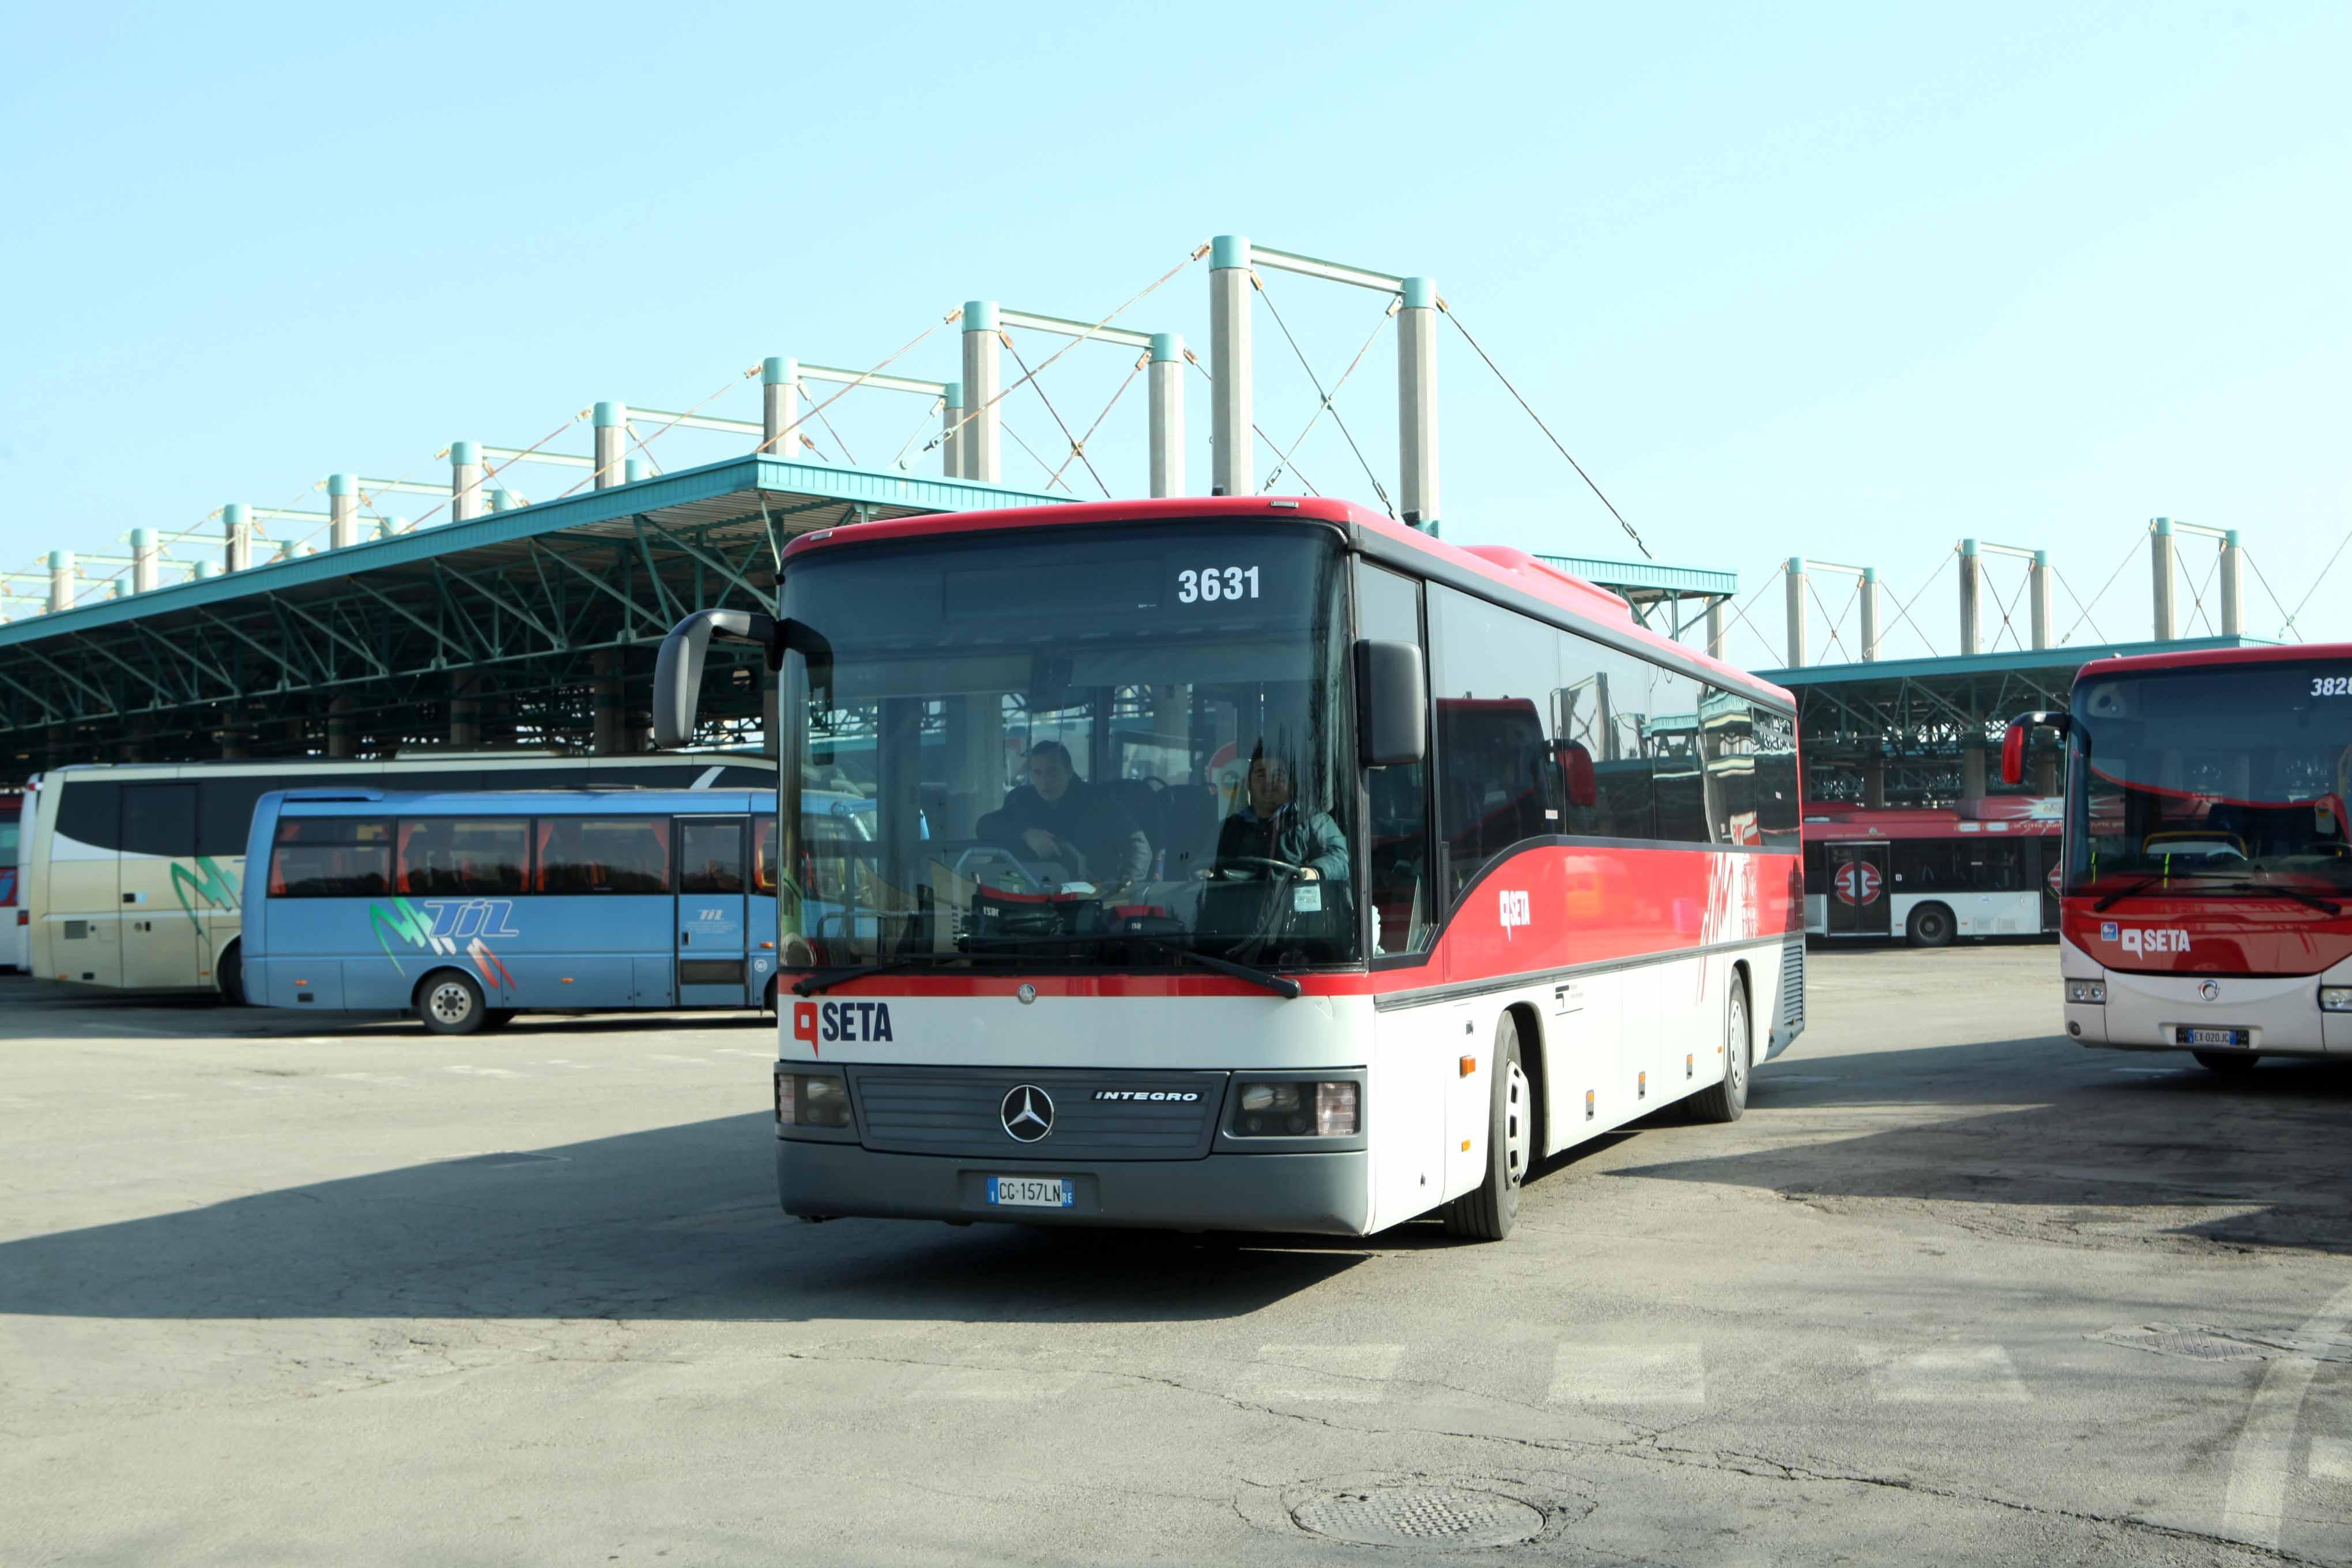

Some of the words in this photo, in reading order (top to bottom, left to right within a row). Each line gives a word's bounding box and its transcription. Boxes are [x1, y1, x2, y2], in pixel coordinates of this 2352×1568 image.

[1178, 566, 1259, 603] 3631
[2143, 929, 2191, 952] SETA
[822, 1001, 894, 1042] SETA
[1095, 1091, 1198, 1101] INTEGRO
